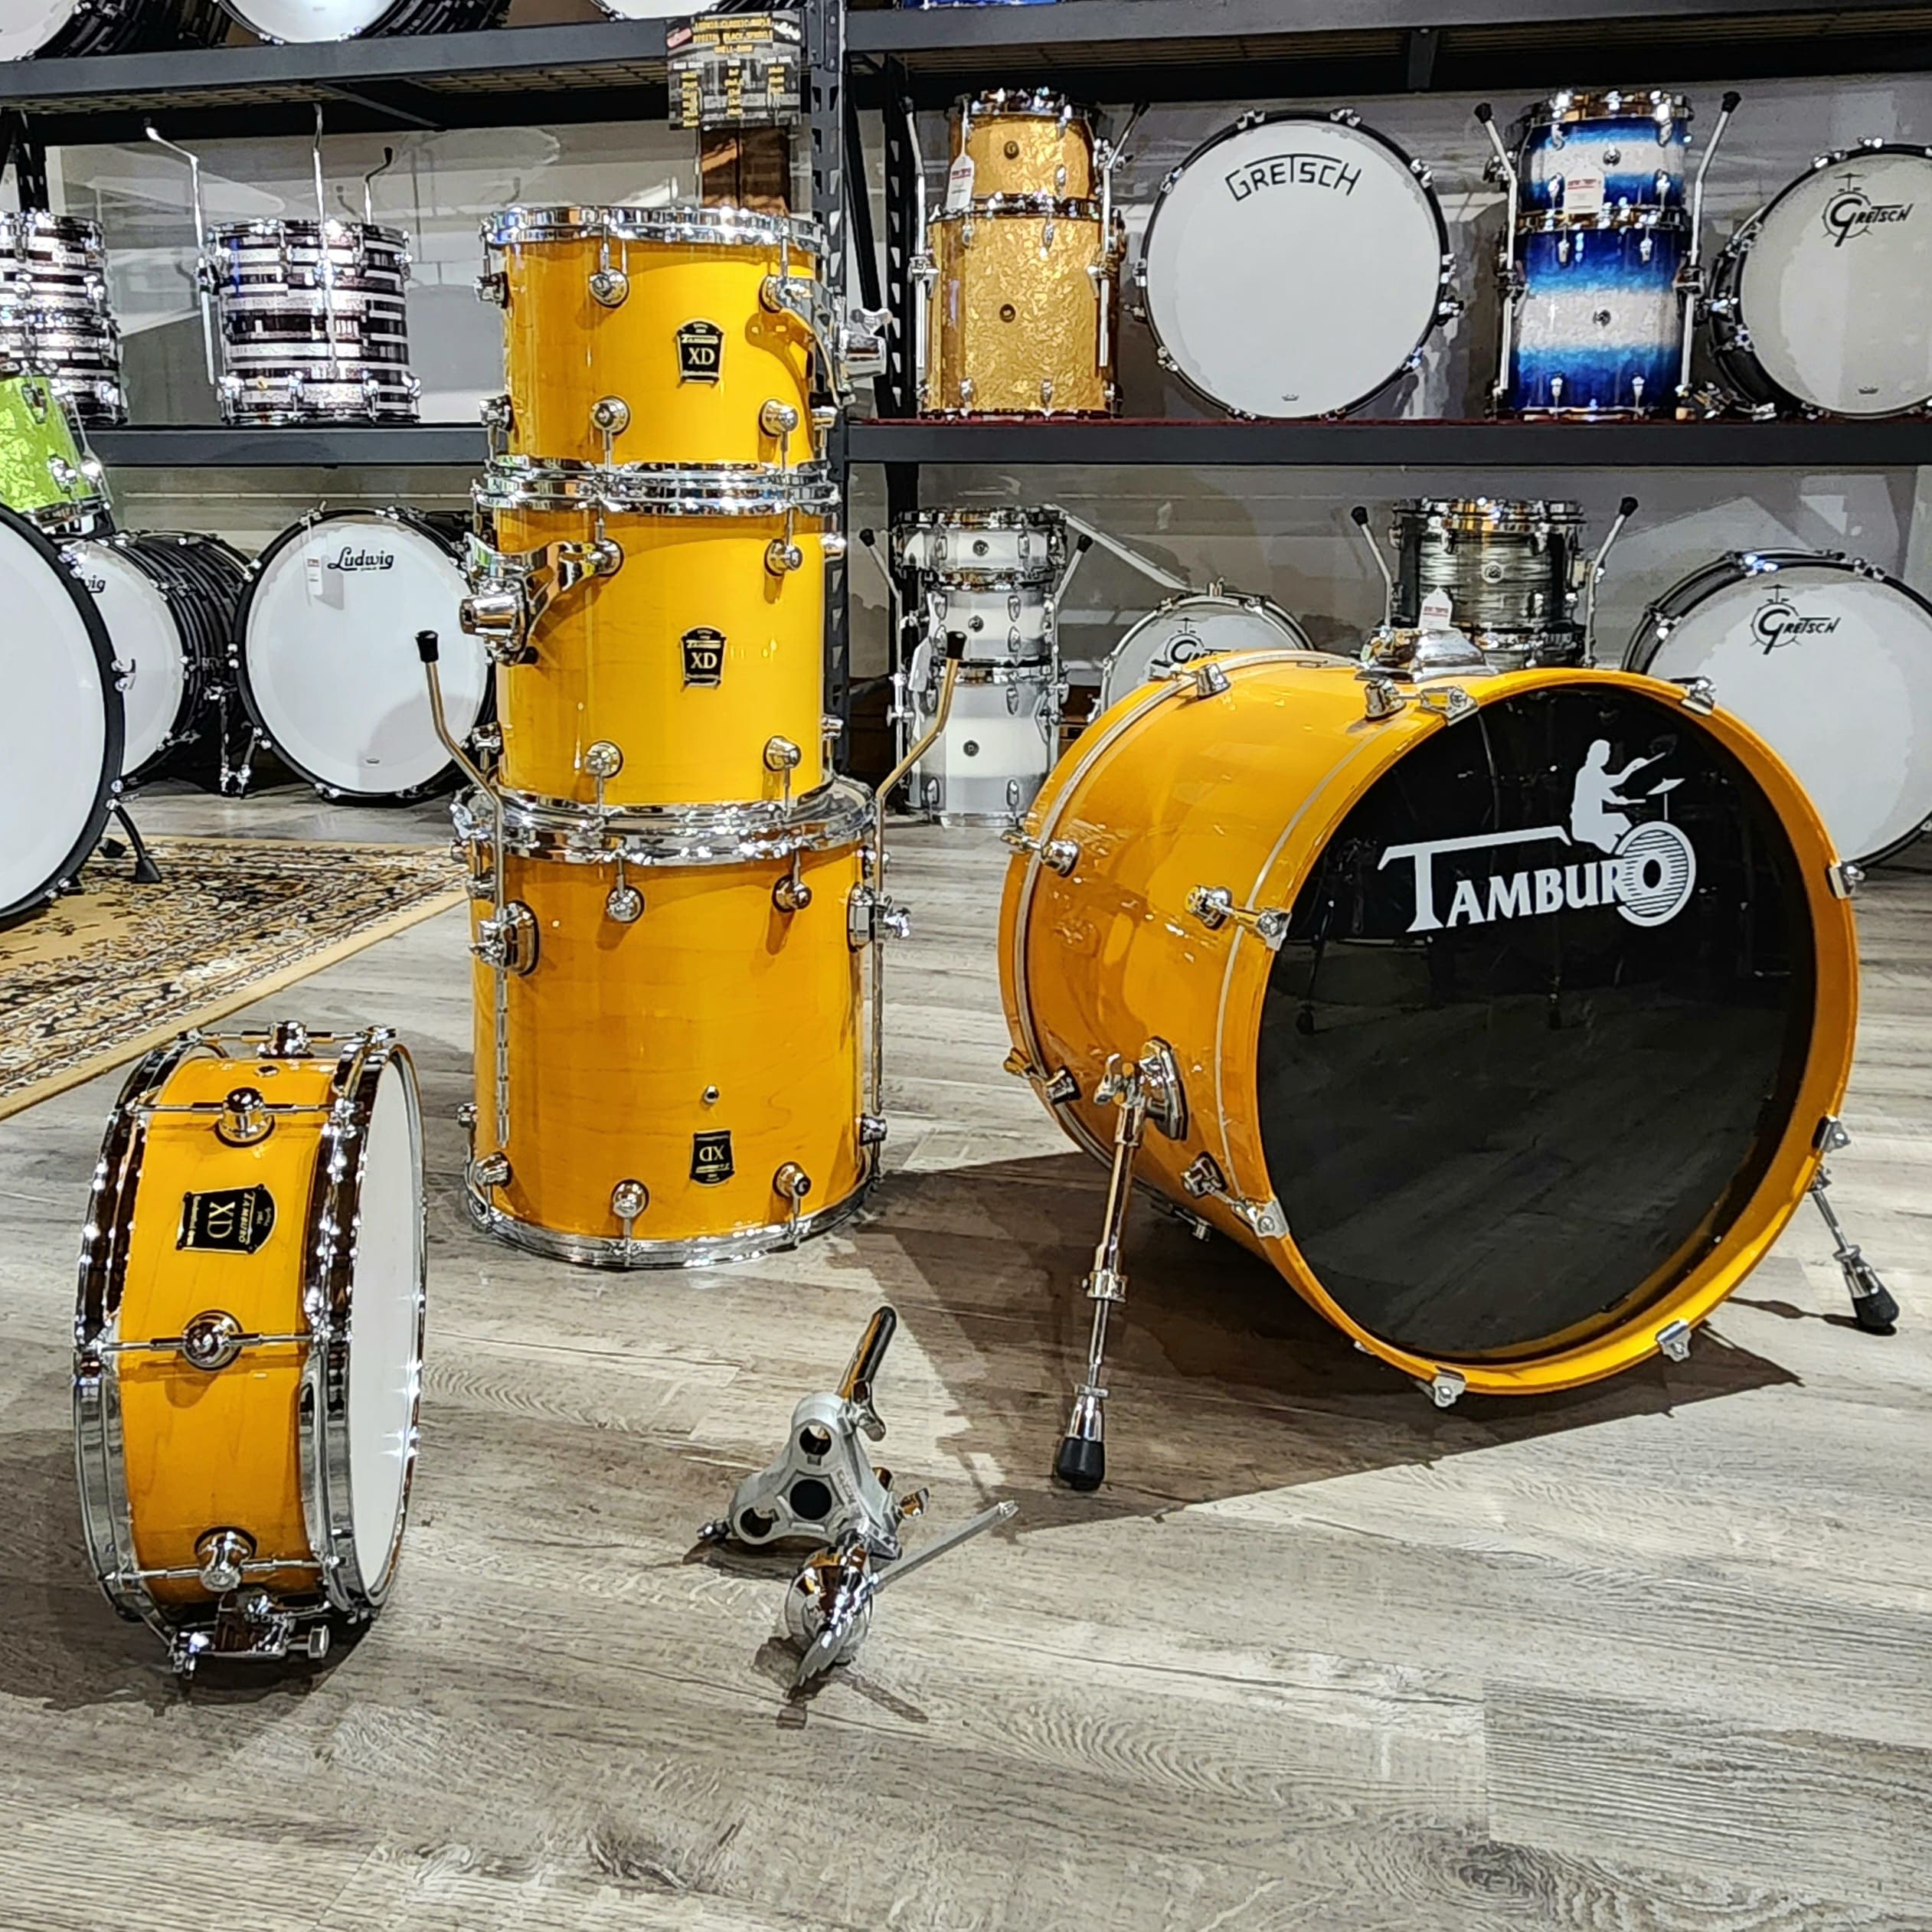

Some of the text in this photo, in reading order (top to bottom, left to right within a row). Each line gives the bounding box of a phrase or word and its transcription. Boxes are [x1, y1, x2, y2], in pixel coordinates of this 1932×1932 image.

[1224, 153, 1362, 201] GRETSCH
[688, 347, 715, 365] XD
[327, 547, 394, 570] Ludwig
[691, 652, 718, 669] XD
[1378, 821, 1696, 933] TAMBURO
[699, 1144, 724, 1162] XD
[208, 1201, 236, 1238] XD
[238, 1191, 256, 1244] TAMBURO
